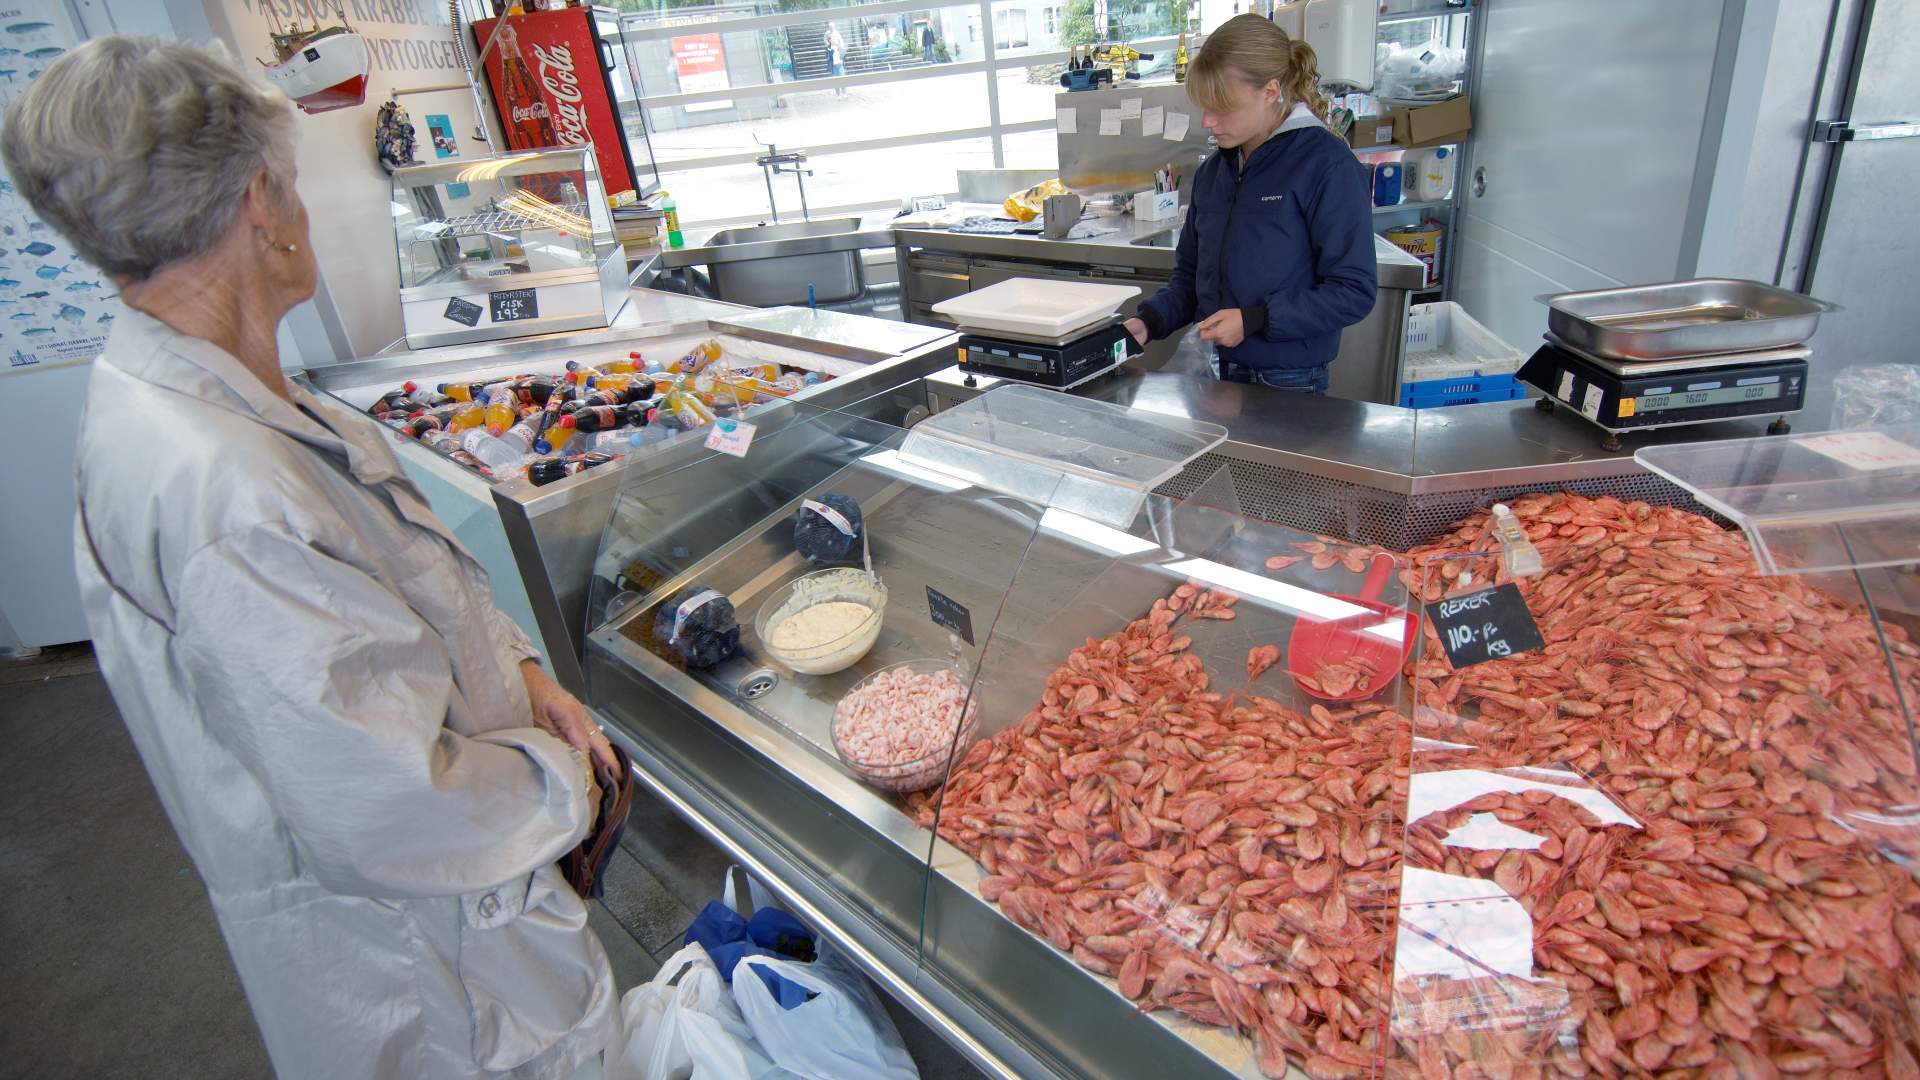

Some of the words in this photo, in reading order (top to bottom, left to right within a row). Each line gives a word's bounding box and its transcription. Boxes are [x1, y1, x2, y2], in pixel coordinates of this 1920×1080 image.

[367, 38, 461, 70] YRTORGET
[496, 308, 519, 320] 195
[500, 300, 524, 309] FISK
[1440, 591, 1496, 618] REKER
